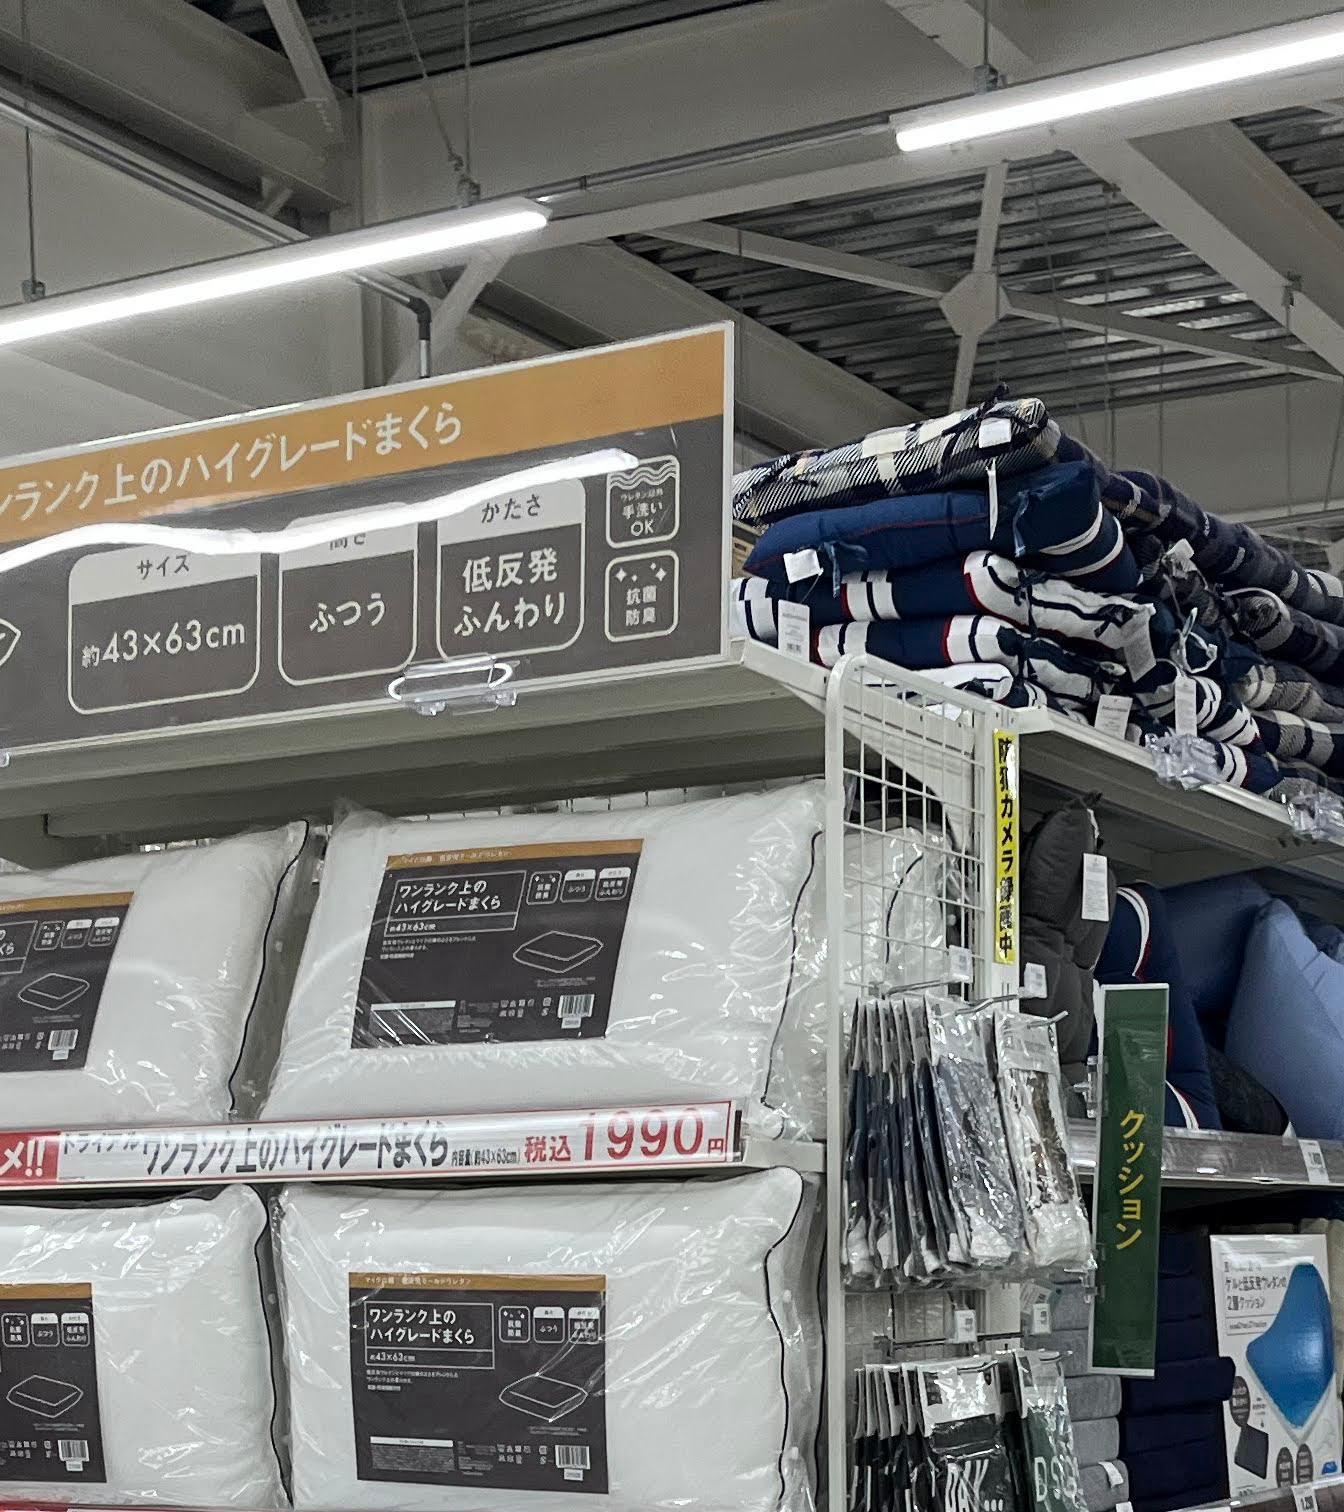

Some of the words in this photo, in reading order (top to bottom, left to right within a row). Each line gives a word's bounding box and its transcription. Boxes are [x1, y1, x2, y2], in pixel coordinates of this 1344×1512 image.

[481, 494, 540, 524] かたさ
[622, 502, 664, 520] 手洗い
[630, 519, 655, 536] OK
[137, 554, 190, 580] サイズ
[462, 547, 558, 593] 低反発
[626, 585, 657, 605] 抗菌
[309, 592, 385, 633] ふつう
[454, 591, 566, 637] ふんわり
[81, 619, 246, 668] 約43×63cm
[398, 879, 487, 899] ワンランク上の
[394, 895, 501, 915] ハイグレードまくら
[142, 1118, 450, 1175] ワンランク上のハイグレードまくら
[581, 1107, 706, 1162] 1990
[707, 1138, 725, 1156] 円
[523, 1135, 571, 1162] 税込
[1114, 1108, 1146, 1251] クッション
[368, 1308, 456, 1325] ワンランク上の
[369, 1327, 475, 1345] ハイグレードまくら
